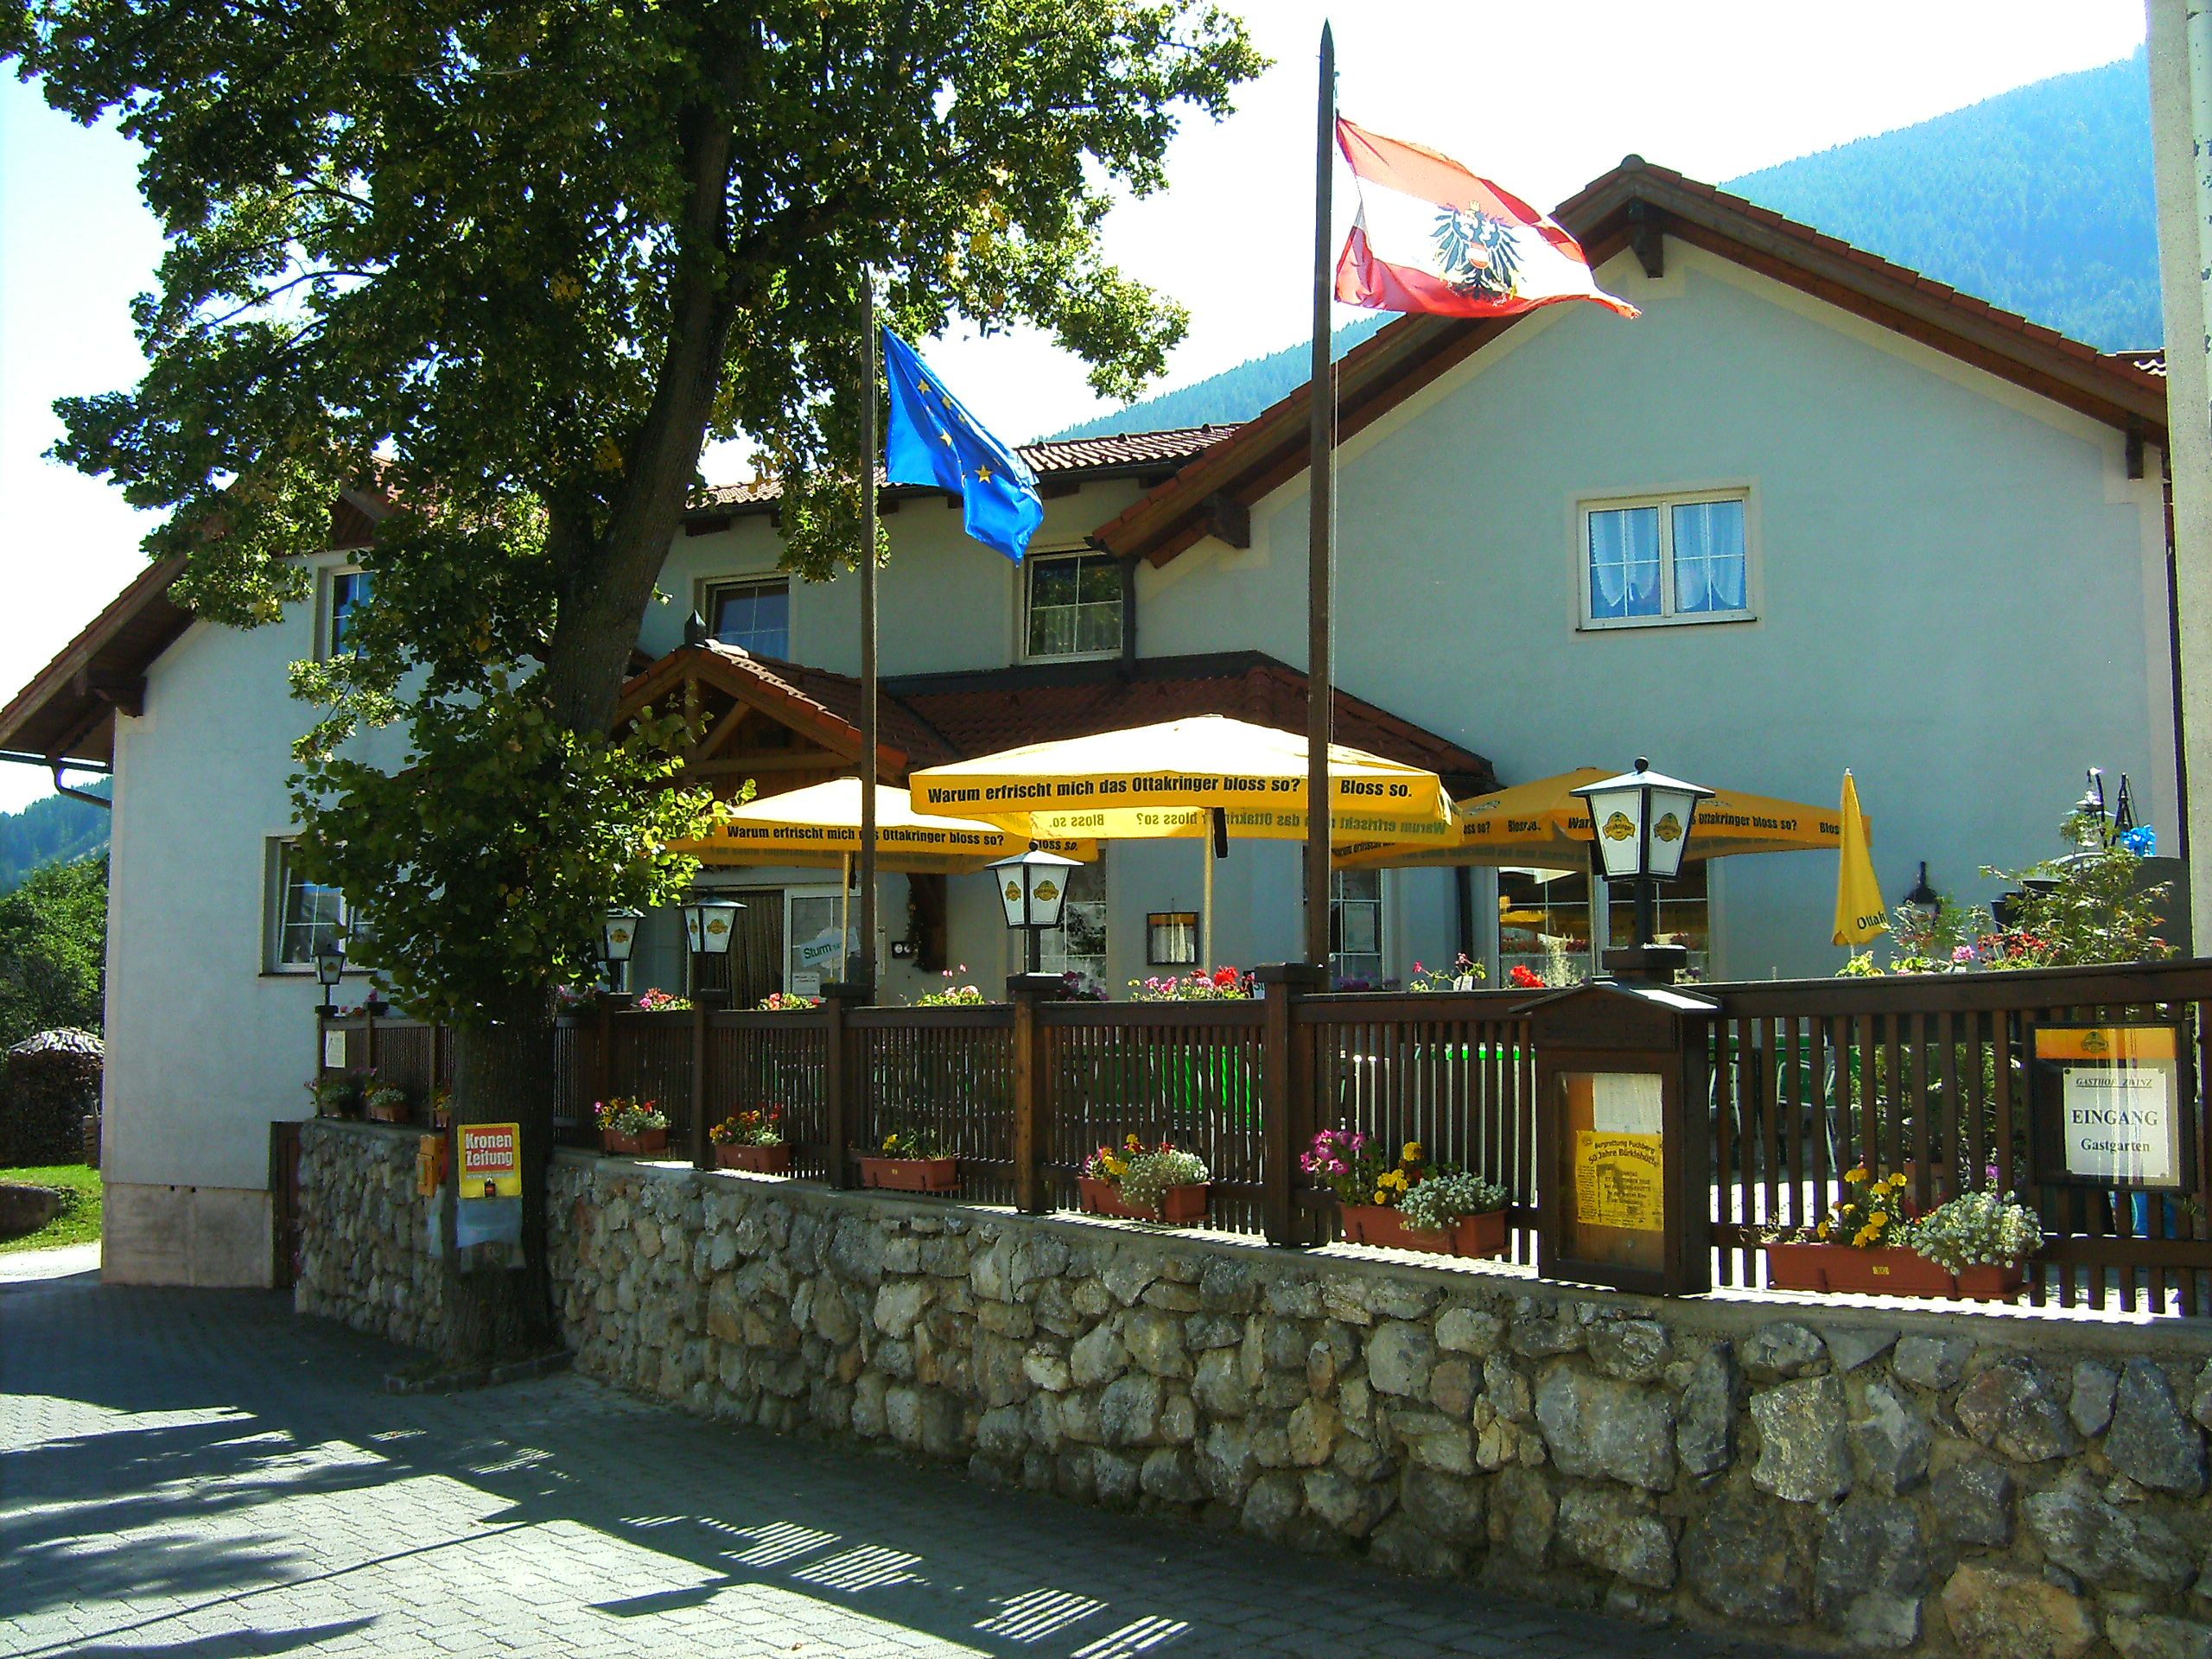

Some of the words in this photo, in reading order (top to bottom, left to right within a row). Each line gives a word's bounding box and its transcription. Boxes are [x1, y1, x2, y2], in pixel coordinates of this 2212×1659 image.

[927, 787, 980, 804] Warum
[986, 783, 1052, 800] erfrischt
[1057, 780, 1094, 797] mich
[1100, 779, 1127, 793] das
[1132, 776, 1218, 791] Ottakringer
[1224, 777, 1266, 791] bloss
[1271, 778, 1300, 792] so?
[1340, 779, 1384, 796] Bloss
[1389, 783, 1412, 798] so.
[1698, 812, 1750, 827] Ottakringer
[1752, 814, 1778, 827] bloss
[1780, 817, 1798, 831] so?
[1819, 821, 1840, 836] Blos
[728, 825, 770, 837] Warum
[773, 827, 823, 839] erfrischt
[827, 828, 855, 840] mich
[883, 829, 946, 843] Ottakringer
[950, 831, 980, 844] bloss
[983, 836, 1004, 846] so?
[1038, 839, 1061, 850] loss
[1064, 841, 1078, 851] so.
[804, 944, 832, 959] Sturm
[2072, 1109, 2158, 1126] EINGANG
[465, 1133, 512, 1148] Kronen
[2081, 1138, 2150, 1154] Gastgarten
[466, 1149, 512, 1166] Zeitung
